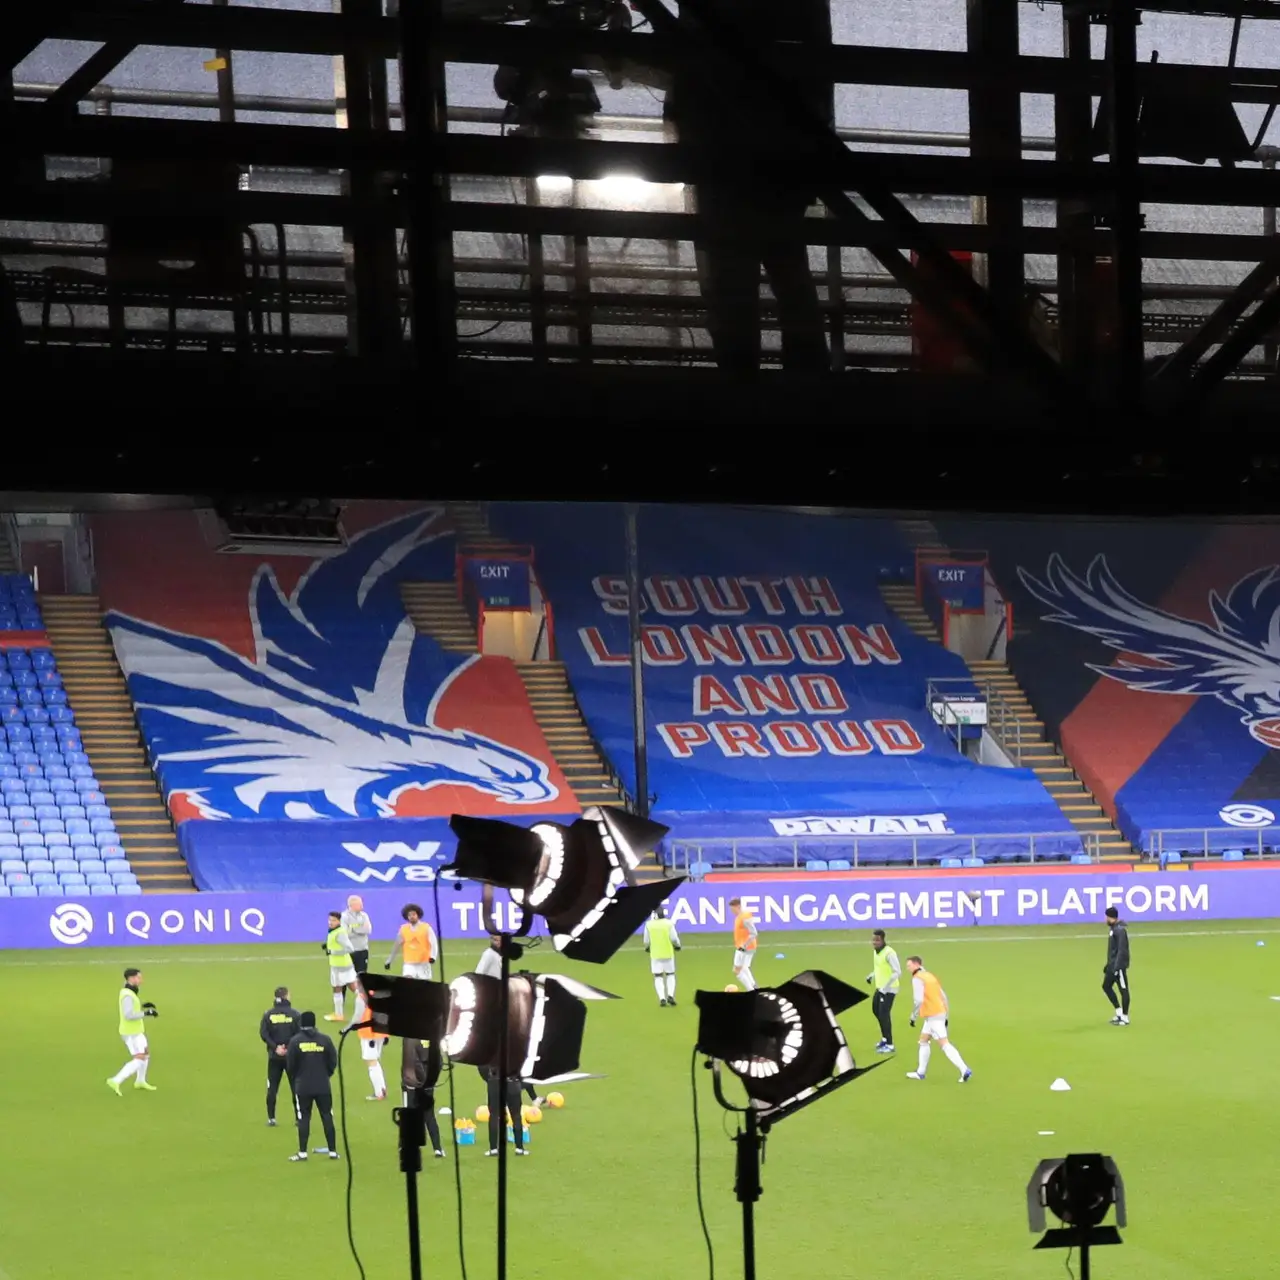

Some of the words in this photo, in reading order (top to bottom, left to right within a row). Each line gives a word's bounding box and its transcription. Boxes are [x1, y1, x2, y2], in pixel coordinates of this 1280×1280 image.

[480, 565, 510, 578] EXIT
[938, 569, 966, 582] EXIT
[591, 575, 845, 617] SOUTH
[578, 623, 902, 667] LONDON
[692, 673, 849, 717] AND
[655, 719, 925, 758] PROUD
[107, 908, 265, 939] IQONIQ
[452, 902, 524, 931] THE
[740, 889, 1001, 924] ENGAGEMENT
[1018, 884, 1210, 916] PLATFORM
